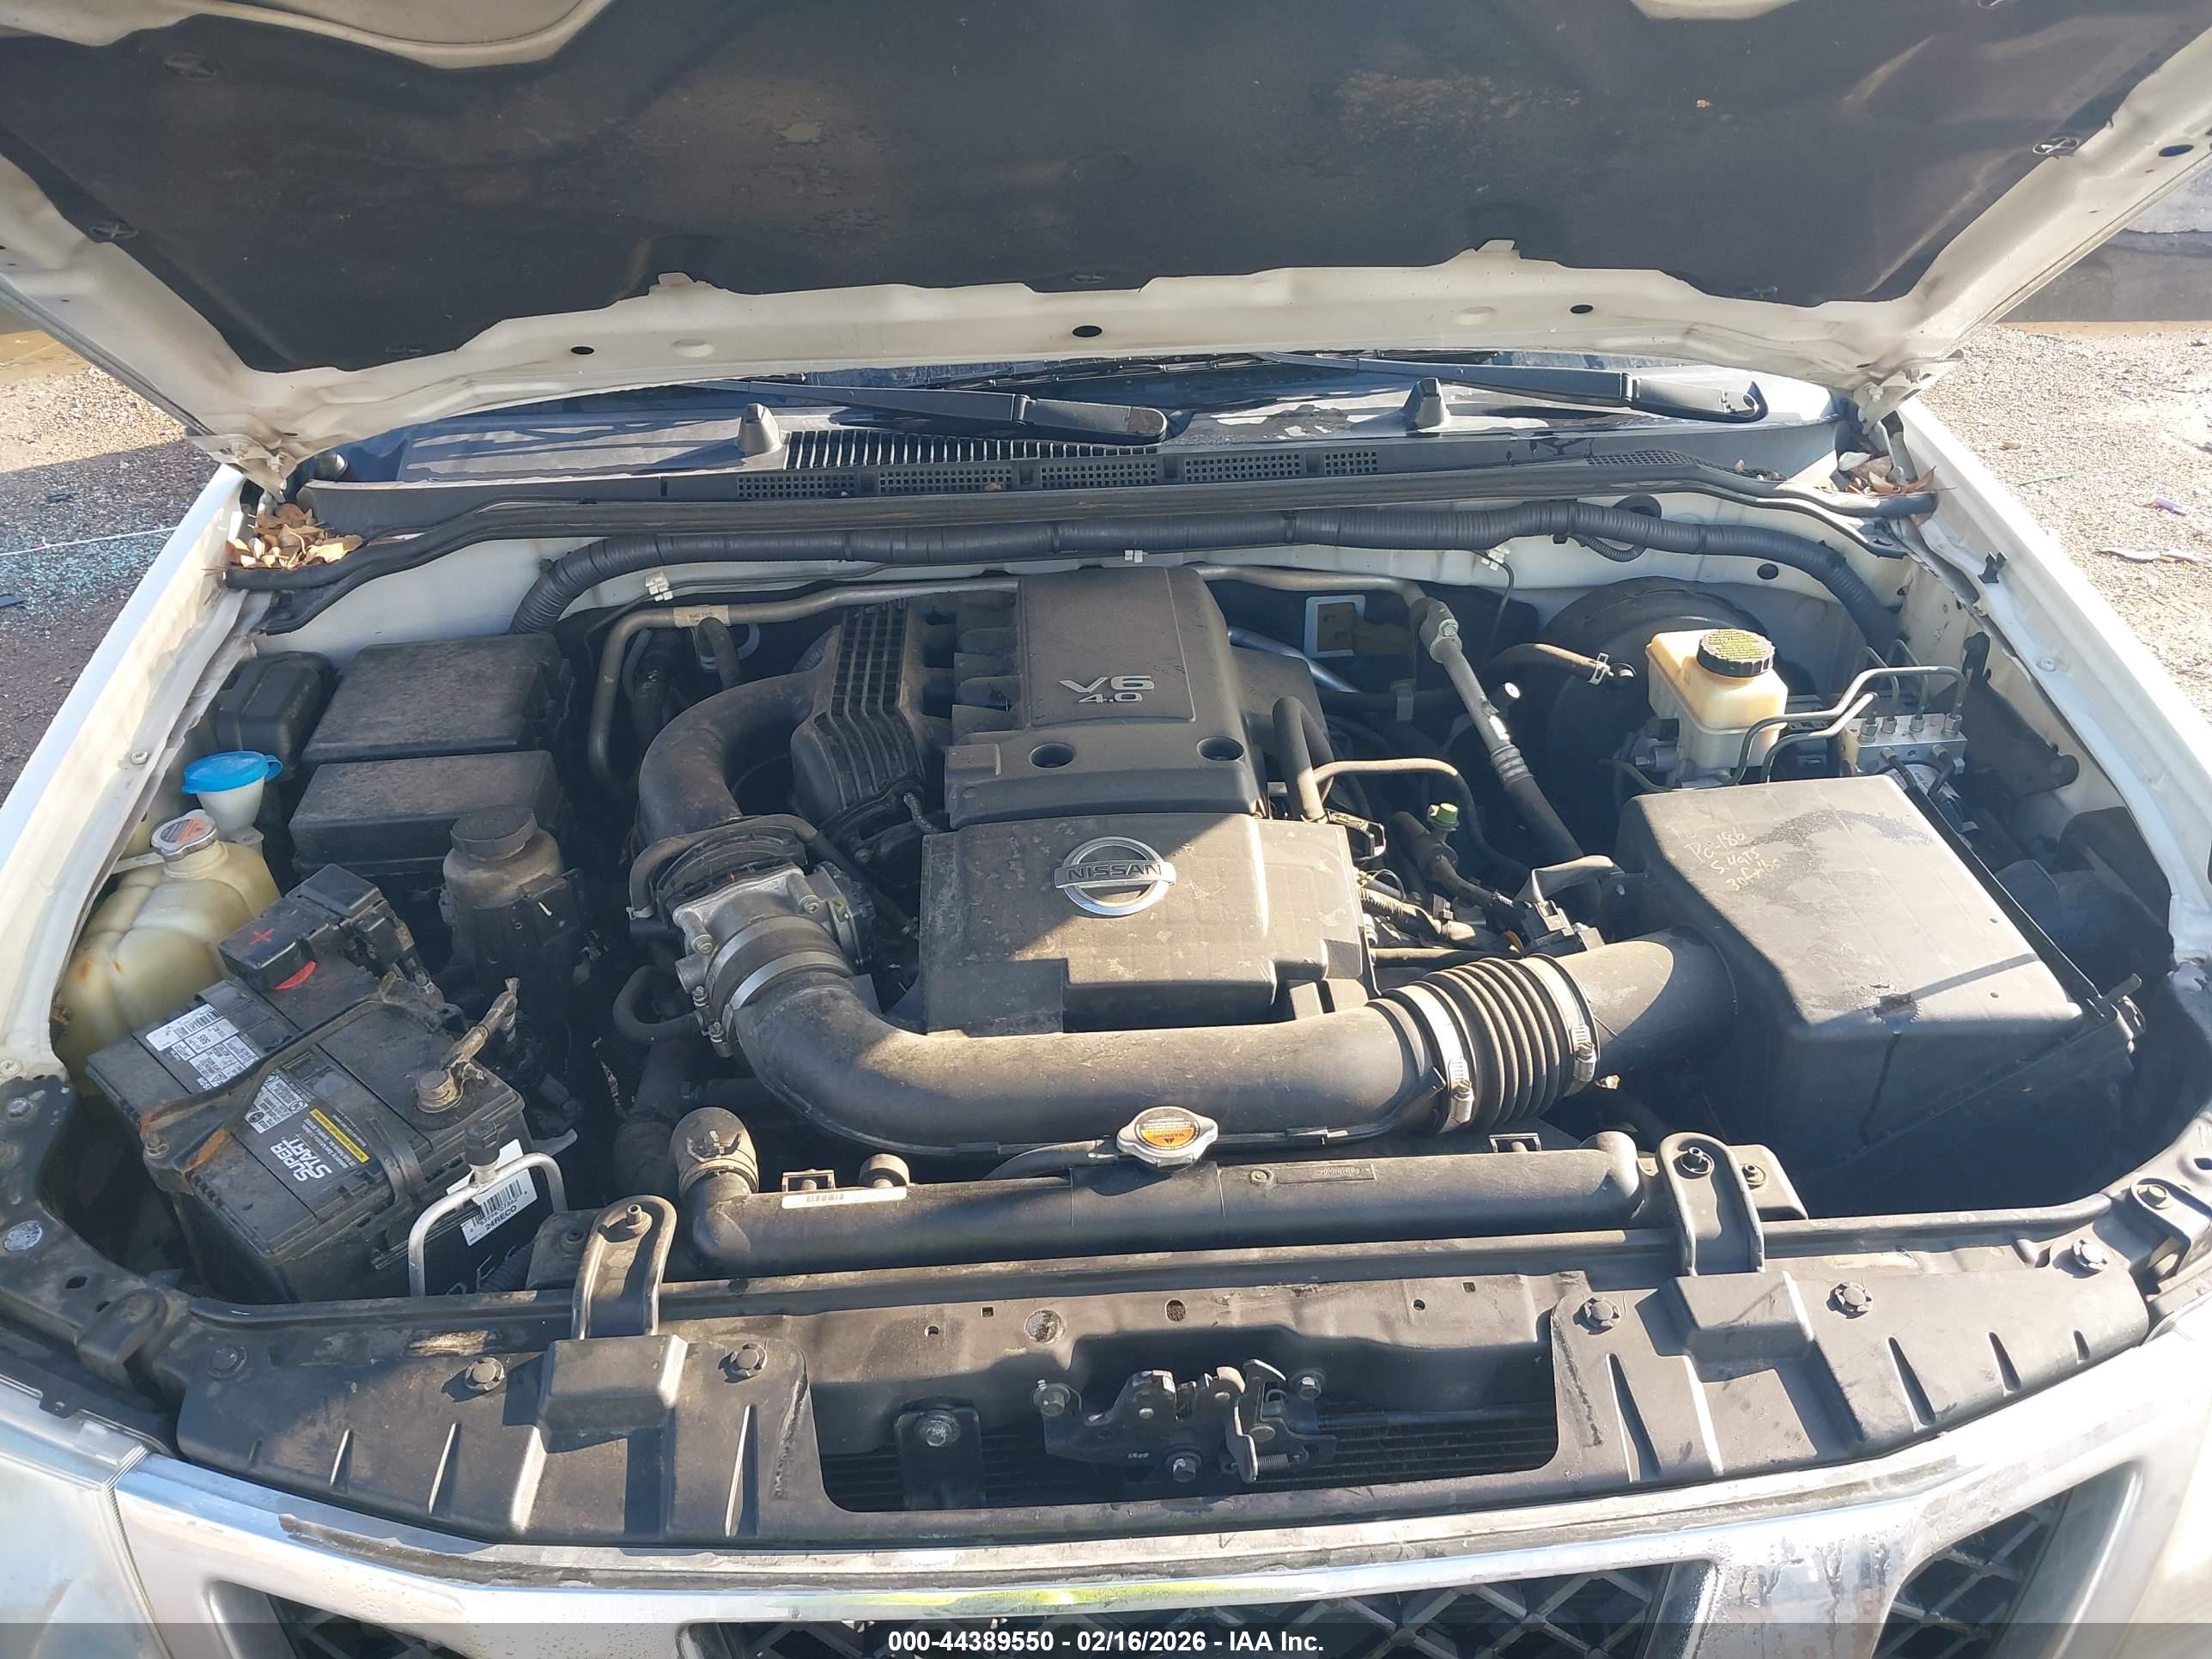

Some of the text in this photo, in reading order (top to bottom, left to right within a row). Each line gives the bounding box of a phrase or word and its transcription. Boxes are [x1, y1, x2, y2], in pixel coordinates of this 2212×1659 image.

[1058, 675, 1155, 694] V6
[1079, 692, 1144, 704] 4.0
[1067, 862, 1162, 882] NISSAN
[270, 1142, 308, 1182] SUPER
[282, 1139, 333, 1179] START
[485, 1205, 518, 1231] 24RECO
